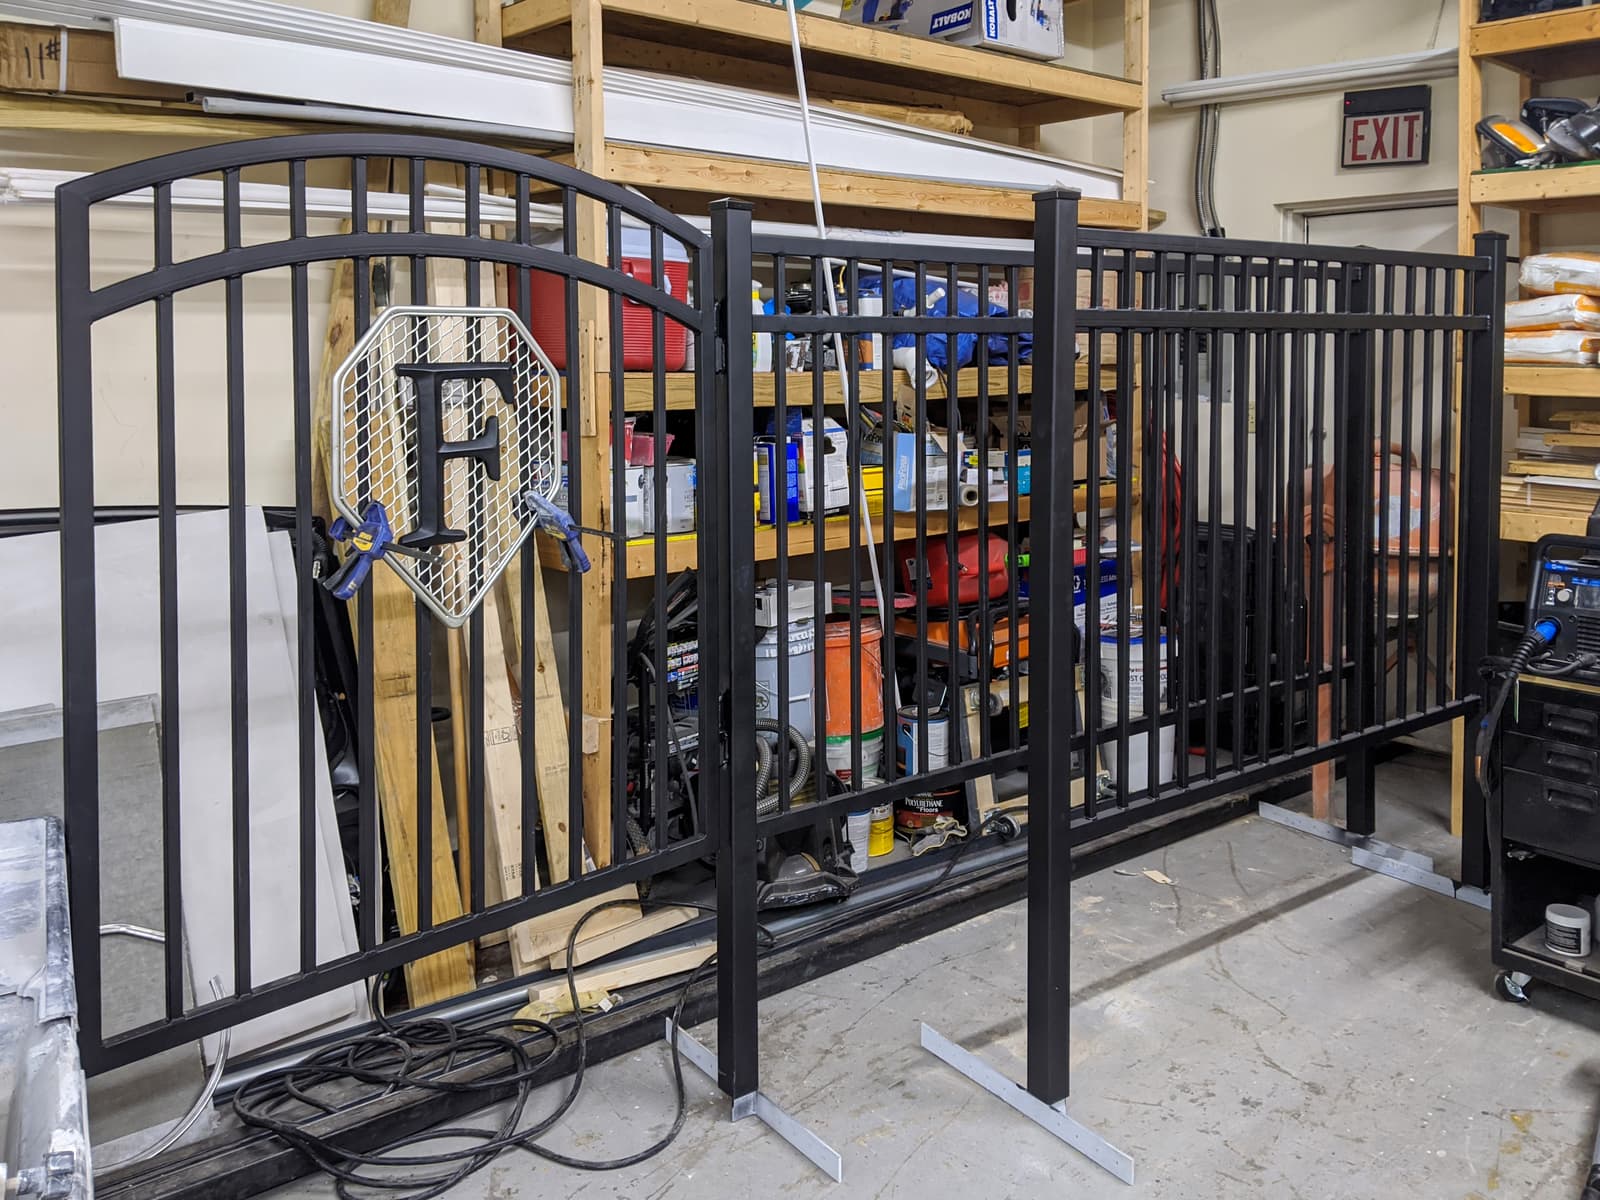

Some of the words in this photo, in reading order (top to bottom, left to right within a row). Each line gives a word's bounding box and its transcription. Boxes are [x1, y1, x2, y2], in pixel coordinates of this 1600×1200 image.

[932, 8, 971, 28] KOBALT
[988, 0, 996, 37] KOBALT
[1352, 115, 1420, 161] EXIT
[395, 362, 517, 547] F
